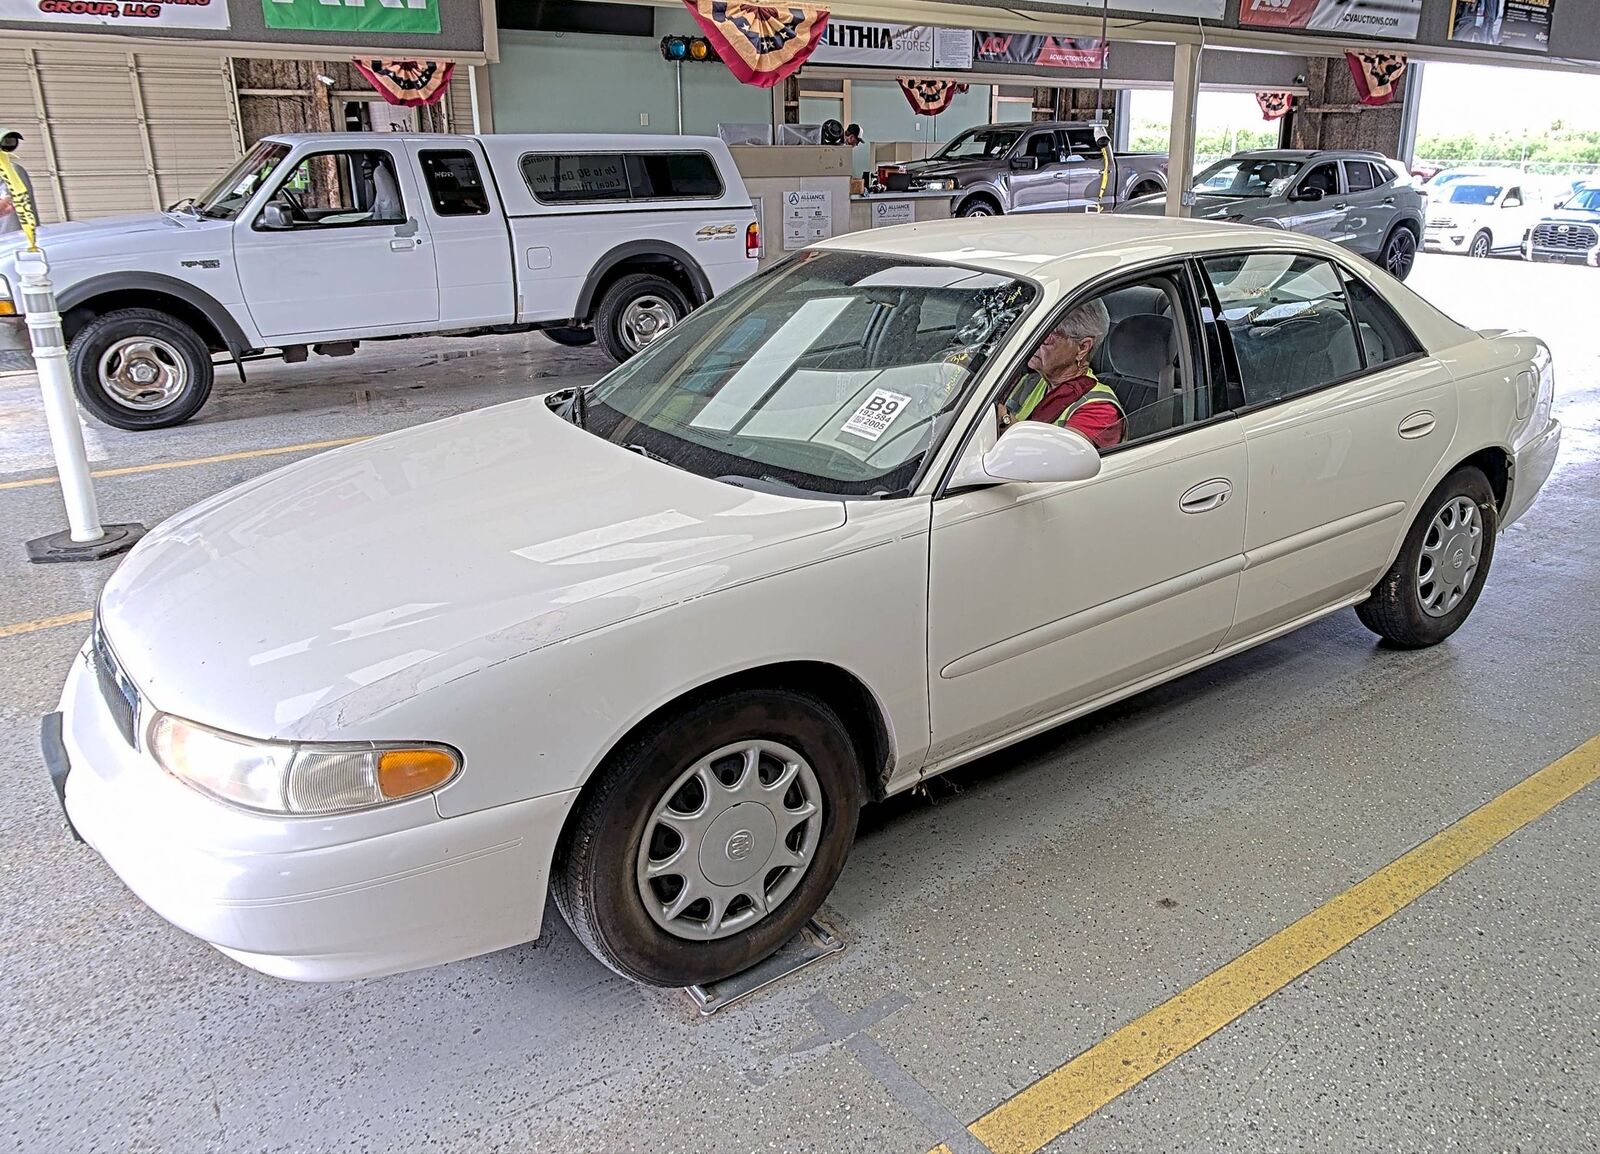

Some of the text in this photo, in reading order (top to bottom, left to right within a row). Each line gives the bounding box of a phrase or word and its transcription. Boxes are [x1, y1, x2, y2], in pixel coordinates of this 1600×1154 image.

[39, 0, 161, 18] GROUP, LLC
[828, 23, 893, 49] LITHIA
[895, 28, 920, 40] AUTO
[895, 40, 931, 52] STORES
[865, 396, 899, 415] B9
[859, 408, 892, 423] 192,584
[863, 418, 886, 431] 2005
